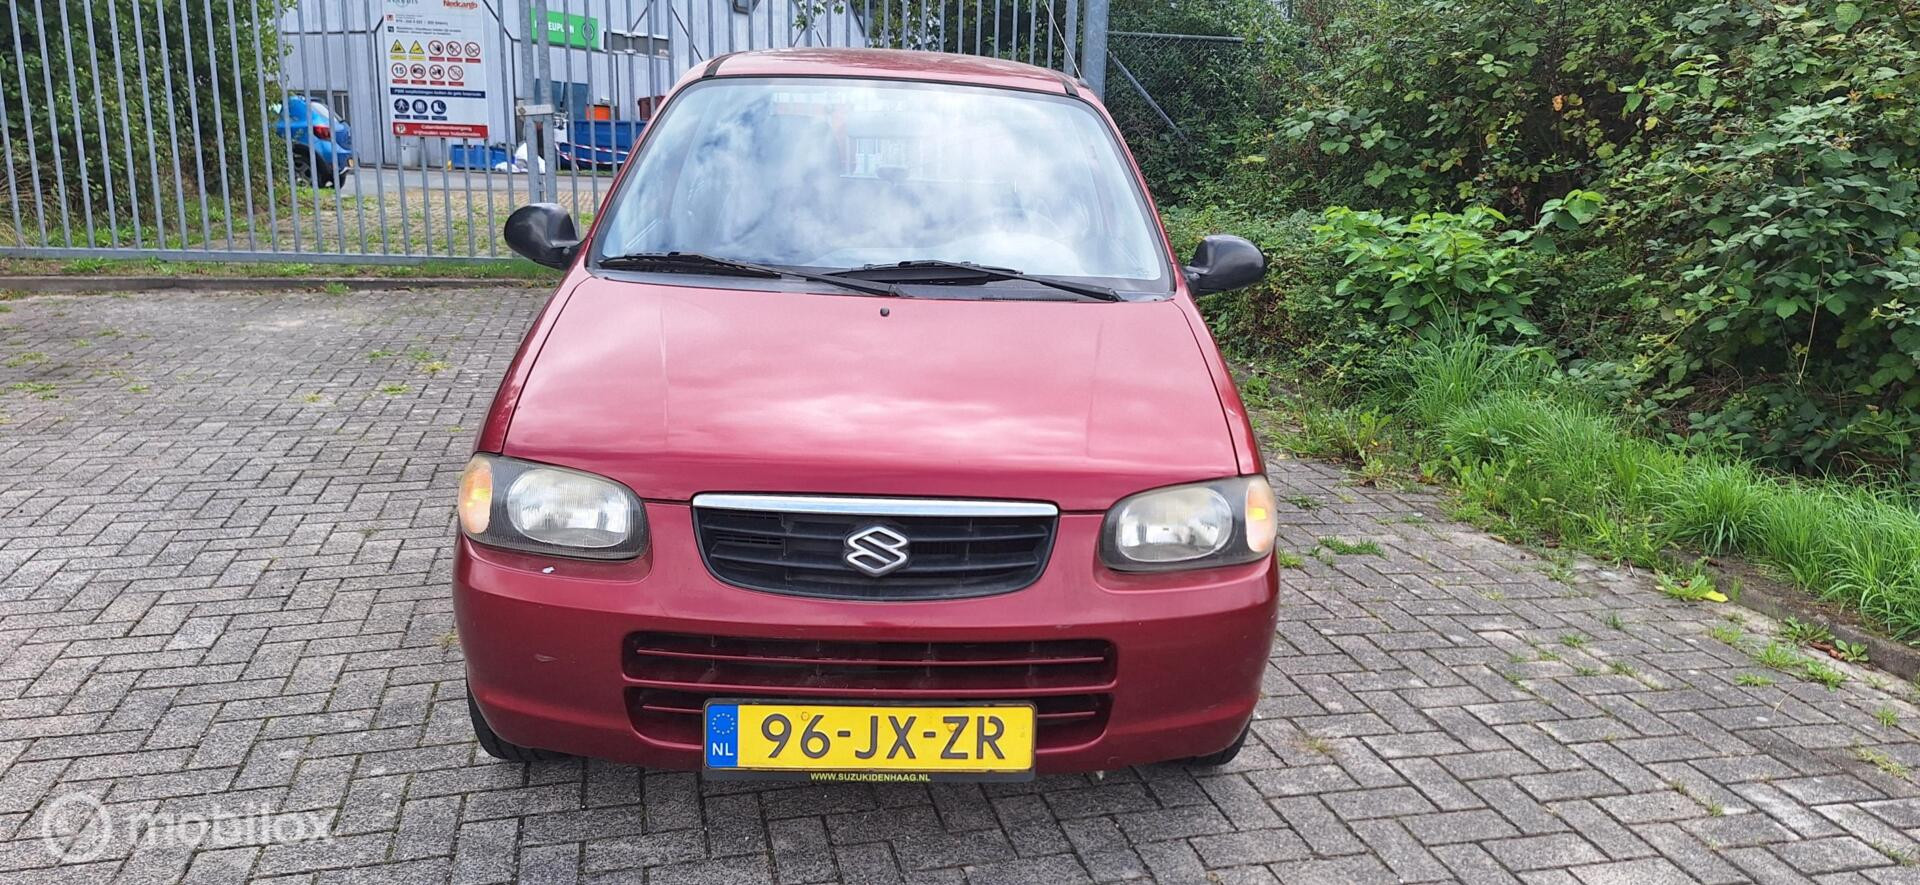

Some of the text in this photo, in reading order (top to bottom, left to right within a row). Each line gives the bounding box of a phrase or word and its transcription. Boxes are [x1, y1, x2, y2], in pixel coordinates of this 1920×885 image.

[394, 66, 404, 74] 15
[760, 713, 1005, 760] 96-JX-ZR
[711, 743, 734, 757] NL
[810, 772, 931, 782] WWW.SUZUKIDENHAAG.NL
